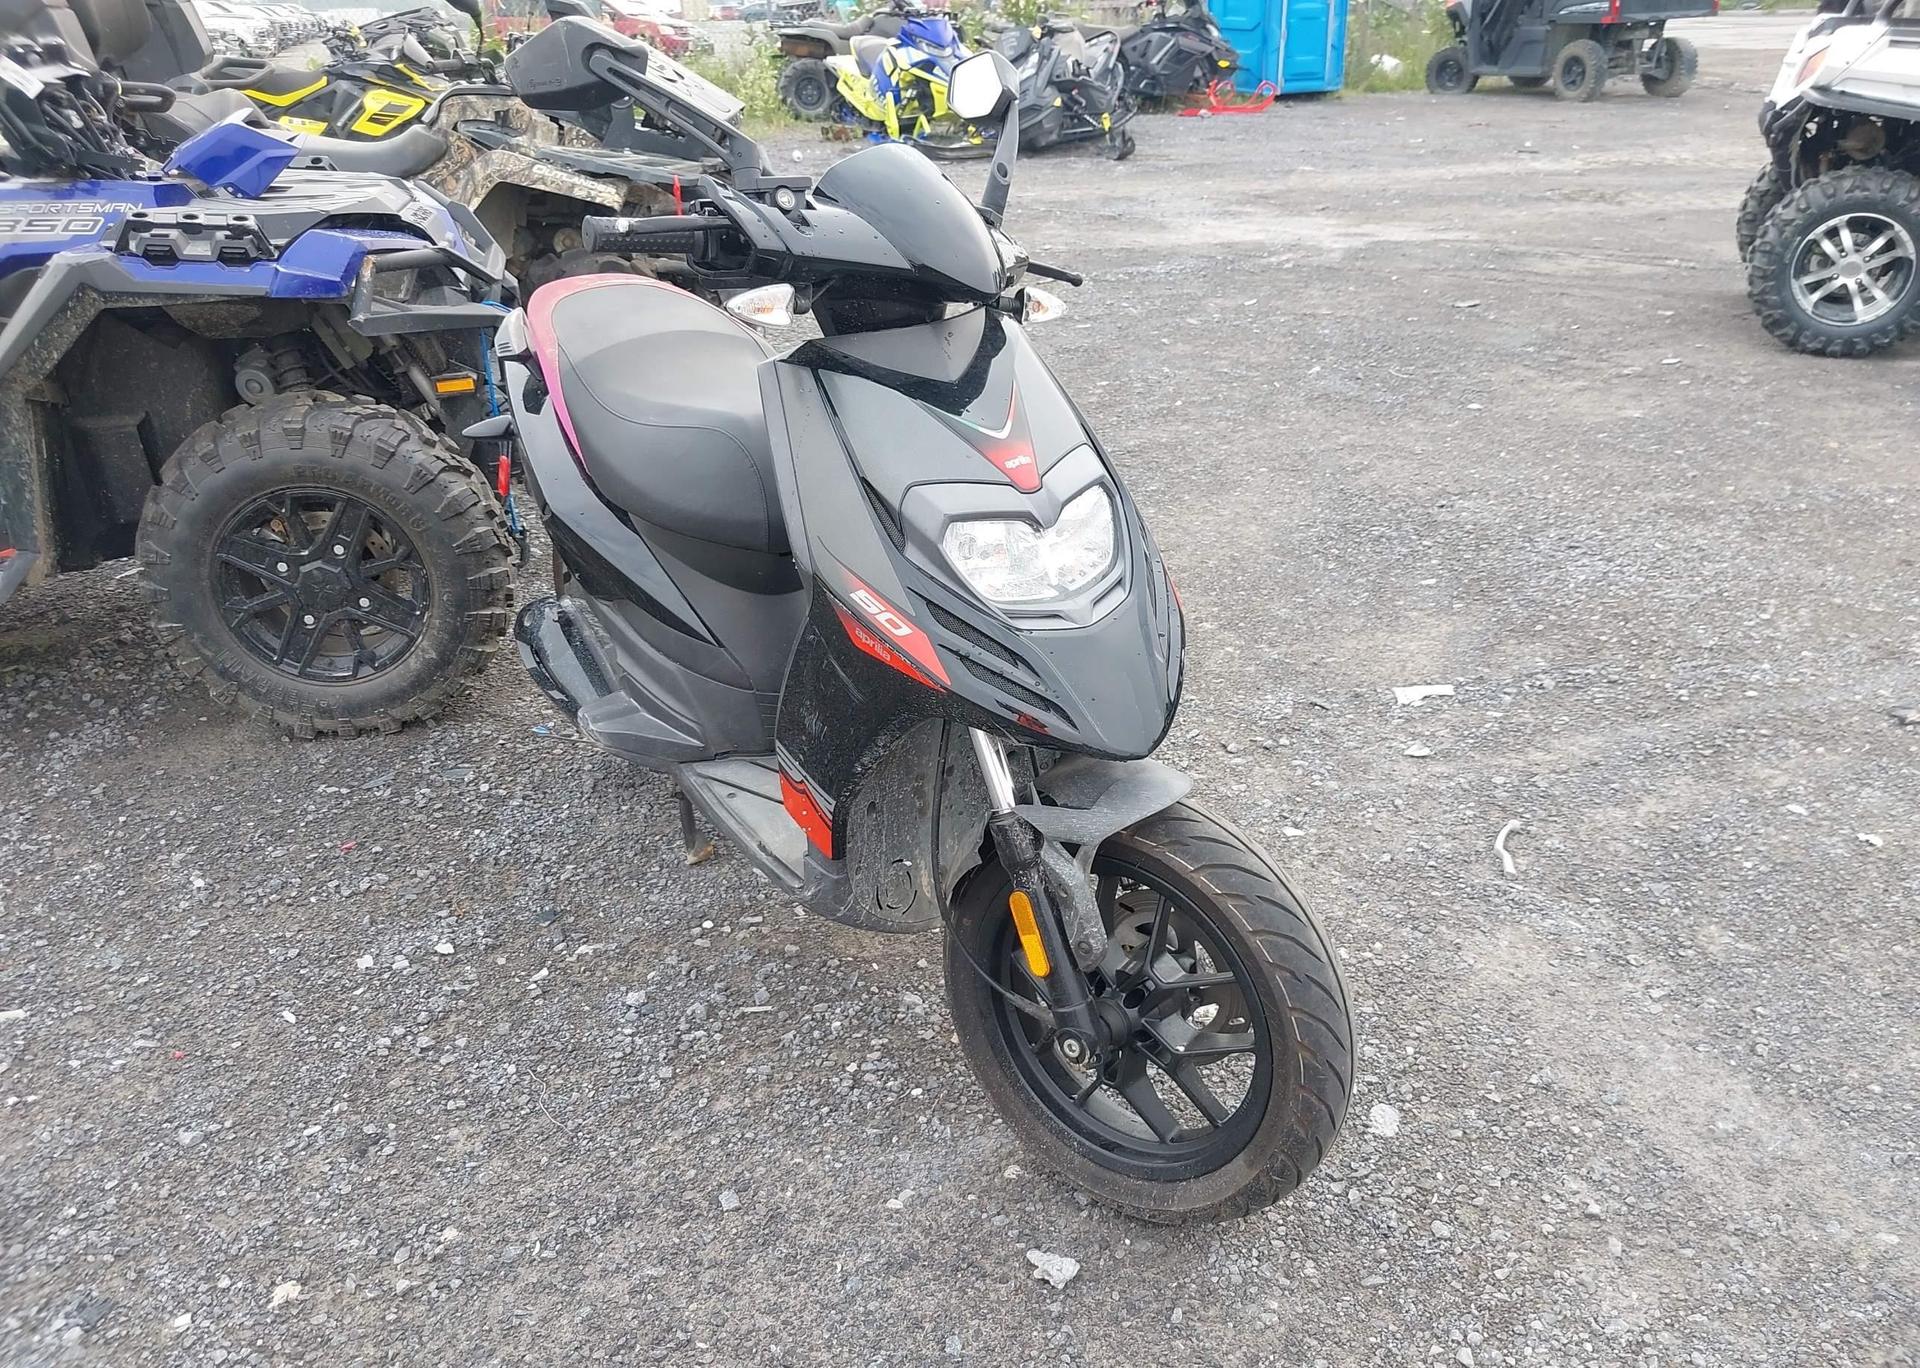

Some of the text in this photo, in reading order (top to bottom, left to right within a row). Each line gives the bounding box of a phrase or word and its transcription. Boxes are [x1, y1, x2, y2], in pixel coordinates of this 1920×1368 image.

[532, 164, 617, 195] OUTLANDER
[849, 589, 913, 636] 50
[855, 628, 891, 661] aprilia
